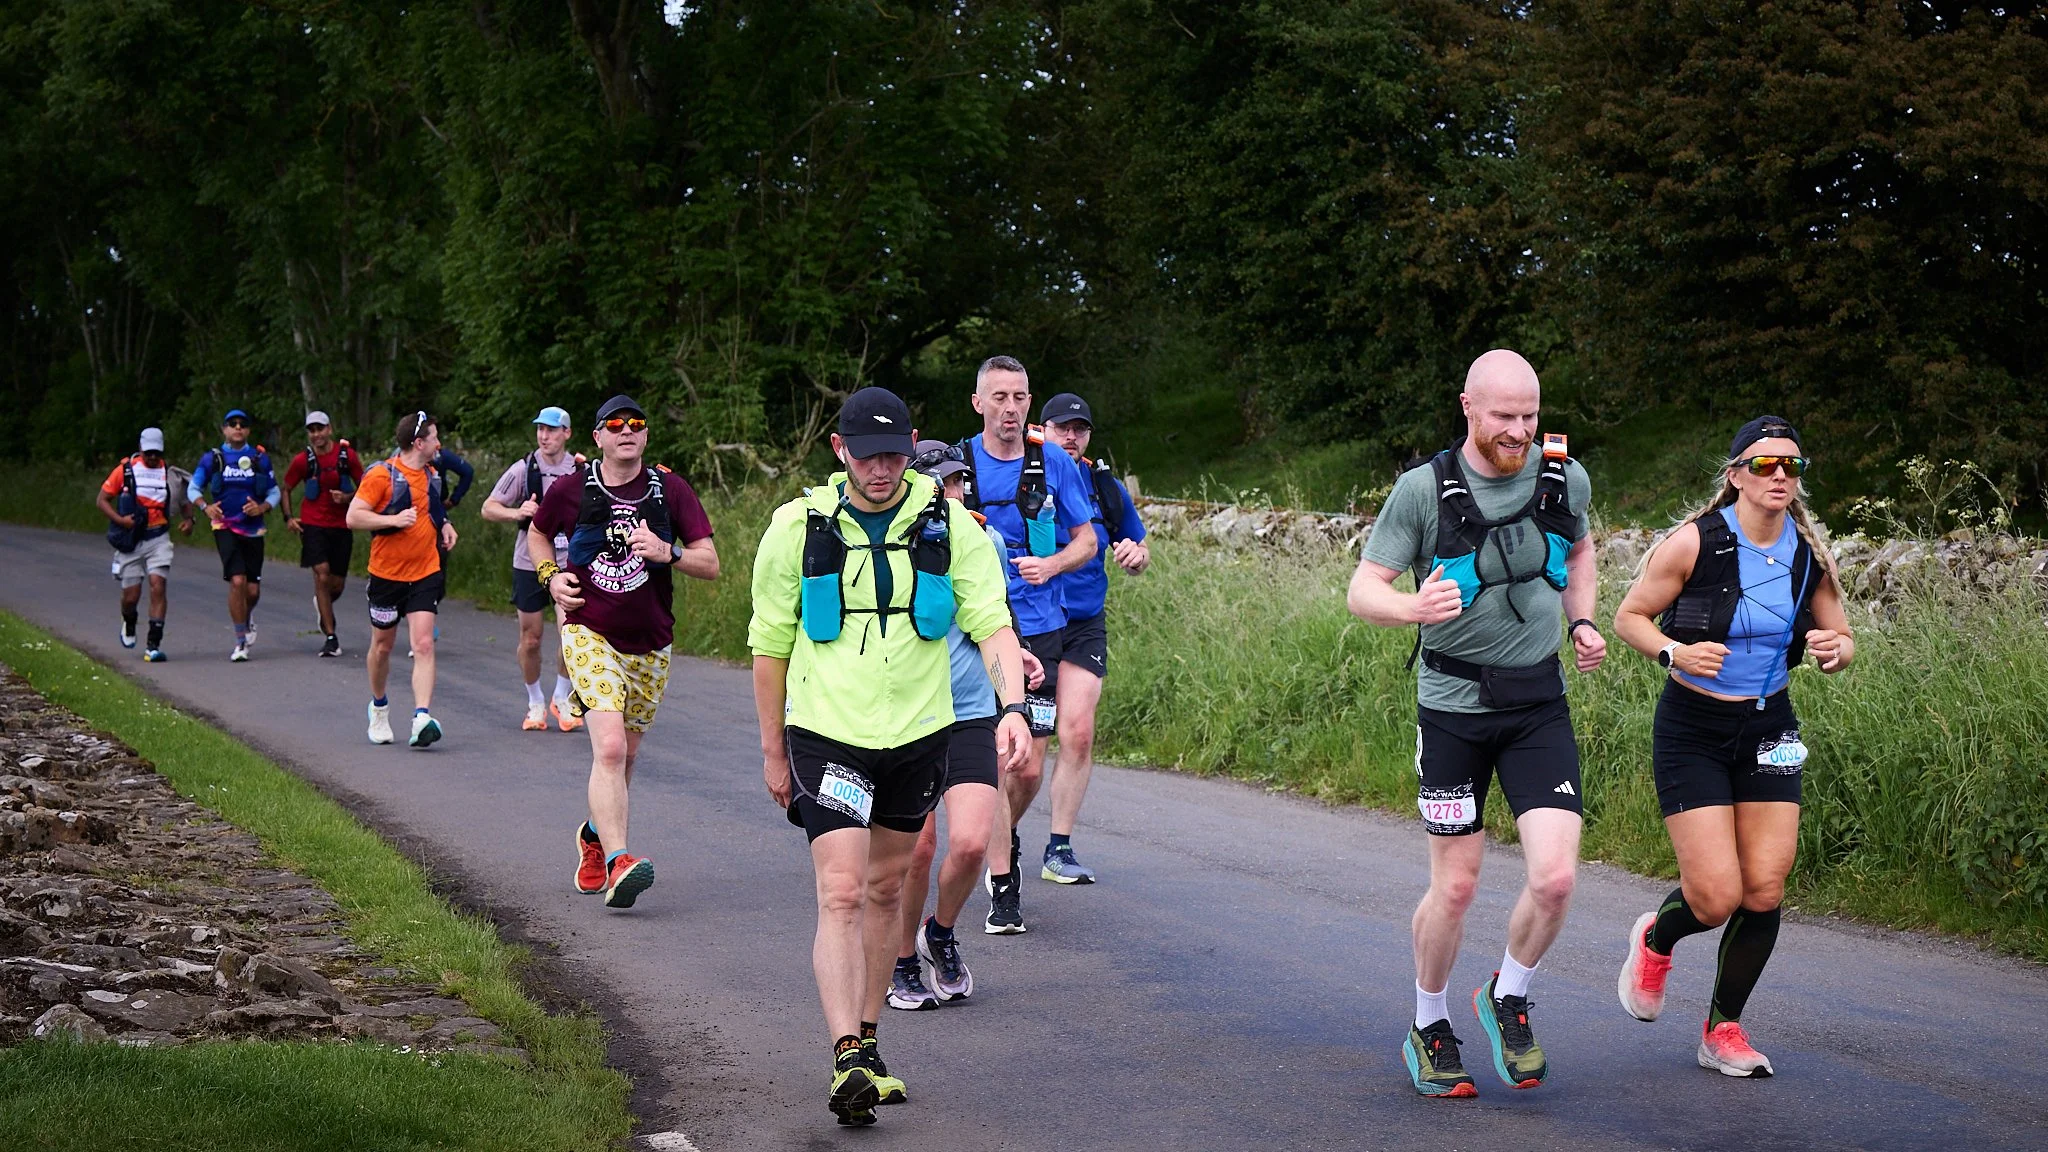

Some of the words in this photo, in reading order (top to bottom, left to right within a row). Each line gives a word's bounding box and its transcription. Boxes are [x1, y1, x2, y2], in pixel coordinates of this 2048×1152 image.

[1033, 708, 1052, 721] 334
[1770, 746, 1801, 764] 0032
[833, 781, 865, 809] 0051
[1425, 802, 1463, 820] 1278
